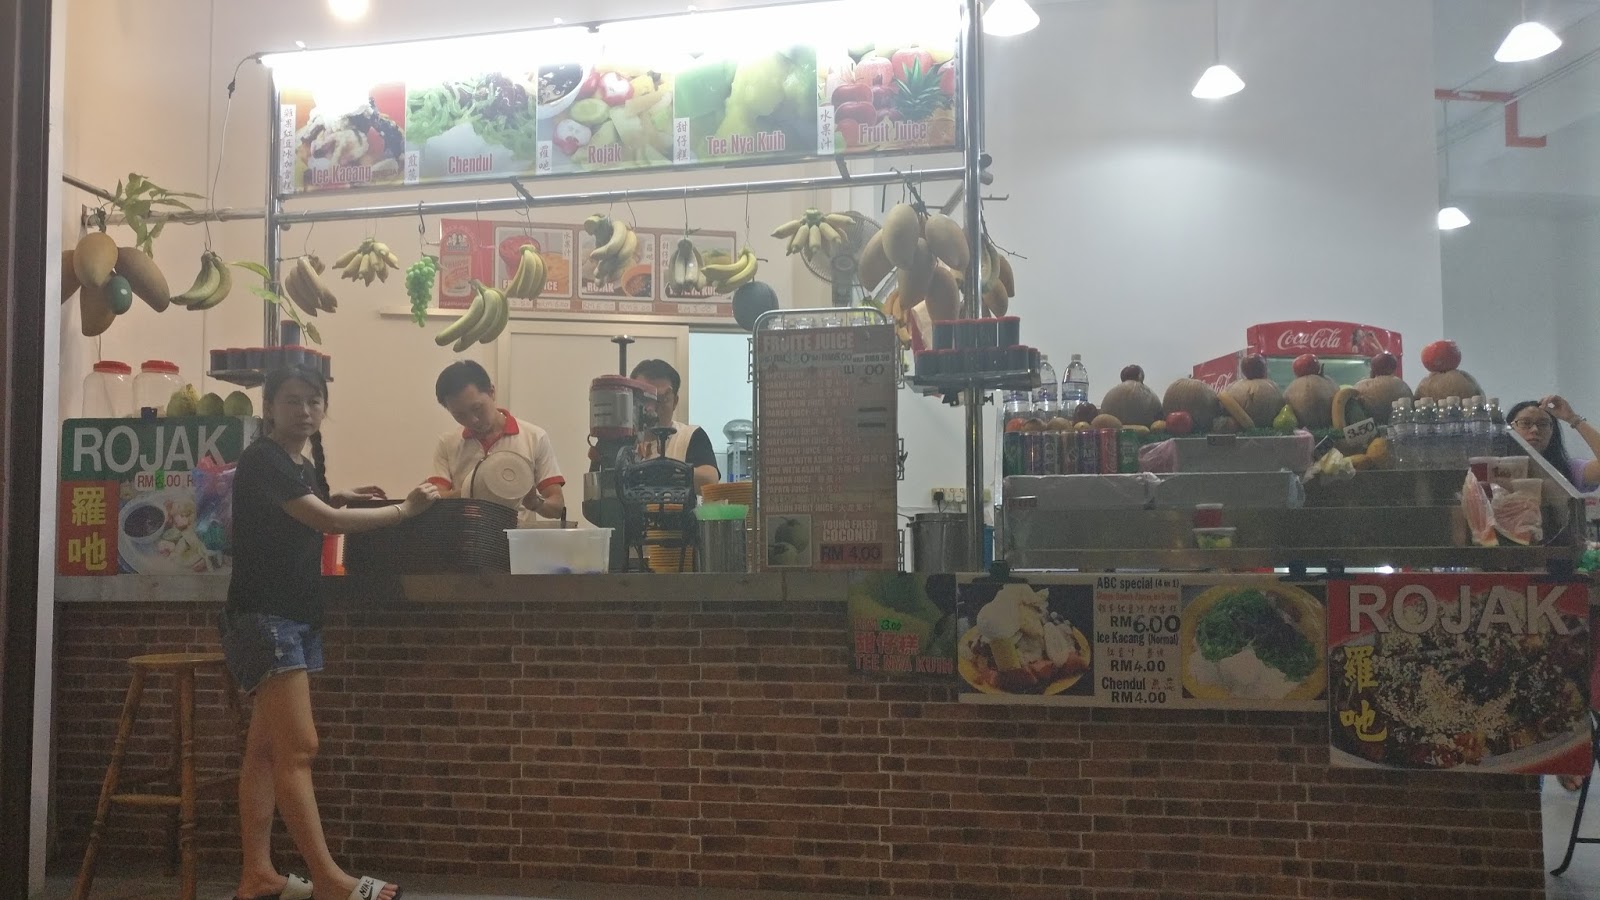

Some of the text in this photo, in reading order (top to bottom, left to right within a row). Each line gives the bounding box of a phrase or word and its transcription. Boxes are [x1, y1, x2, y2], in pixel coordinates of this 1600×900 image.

[820, 109, 832, 151] 水果汁
[859, 120, 928, 144] Fruit Juice
[706, 131, 786, 155] Tee Nya Kuih
[448, 153, 493, 174] Chendul
[588, 143, 622, 165] Rojak
[313, 167, 330, 184] Ice
[332, 164, 372, 184] Kacang
[815, 332, 855, 350] JUICE
[1277, 328, 1342, 349] Coca-Cola
[1347, 421, 1375, 439] 3.50
[73, 425, 227, 473] ROJAK
[822, 519, 878, 530] YOUNG FRESH
[823, 528, 877, 542] COCONUT
[822, 545, 881, 561] RM 4.00
[1097, 577, 1117, 589] ABC
[1119, 577, 1153, 592] special
[1349, 584, 1571, 636] ROJAK
[1097, 632, 1110, 643] Ice
[1112, 632, 1145, 646] Kacang
[855, 654, 954, 675] TEE NYA KUIH
[1101, 677, 1146, 691] Chendul
